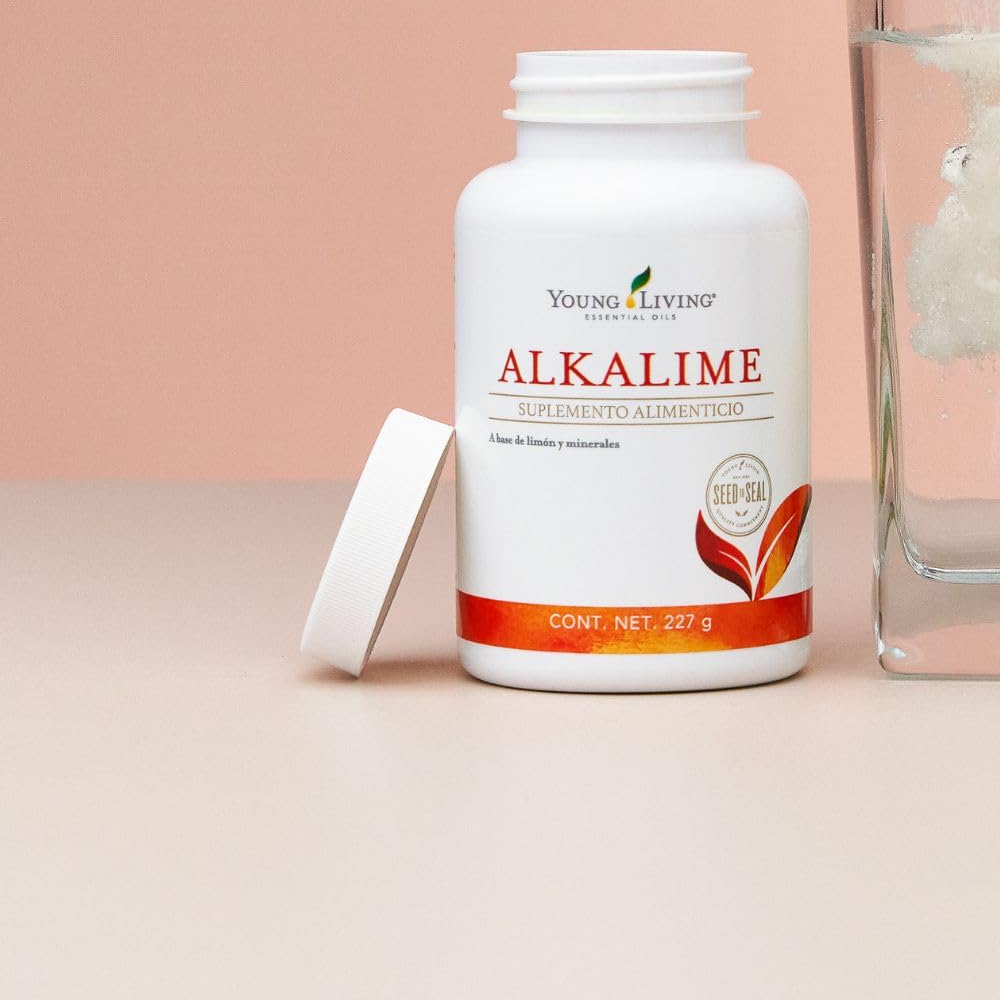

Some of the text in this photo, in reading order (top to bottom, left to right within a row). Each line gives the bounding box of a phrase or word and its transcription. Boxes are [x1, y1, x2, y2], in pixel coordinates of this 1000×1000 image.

[546, 289, 619, 309] YOUNG
[585, 313, 677, 321] ESSENTIAL OILS
[498, 348, 762, 387] ALKALIME
[518, 402, 744, 419] SUPLEMENTO ALIMENTICIO
[488, 433, 620, 450] A base de limón y minerales
[713, 483, 738, 505] SEED
[745, 480, 767, 503] SEAL
[549, 613, 712, 631] CONT. NET. 227 g
